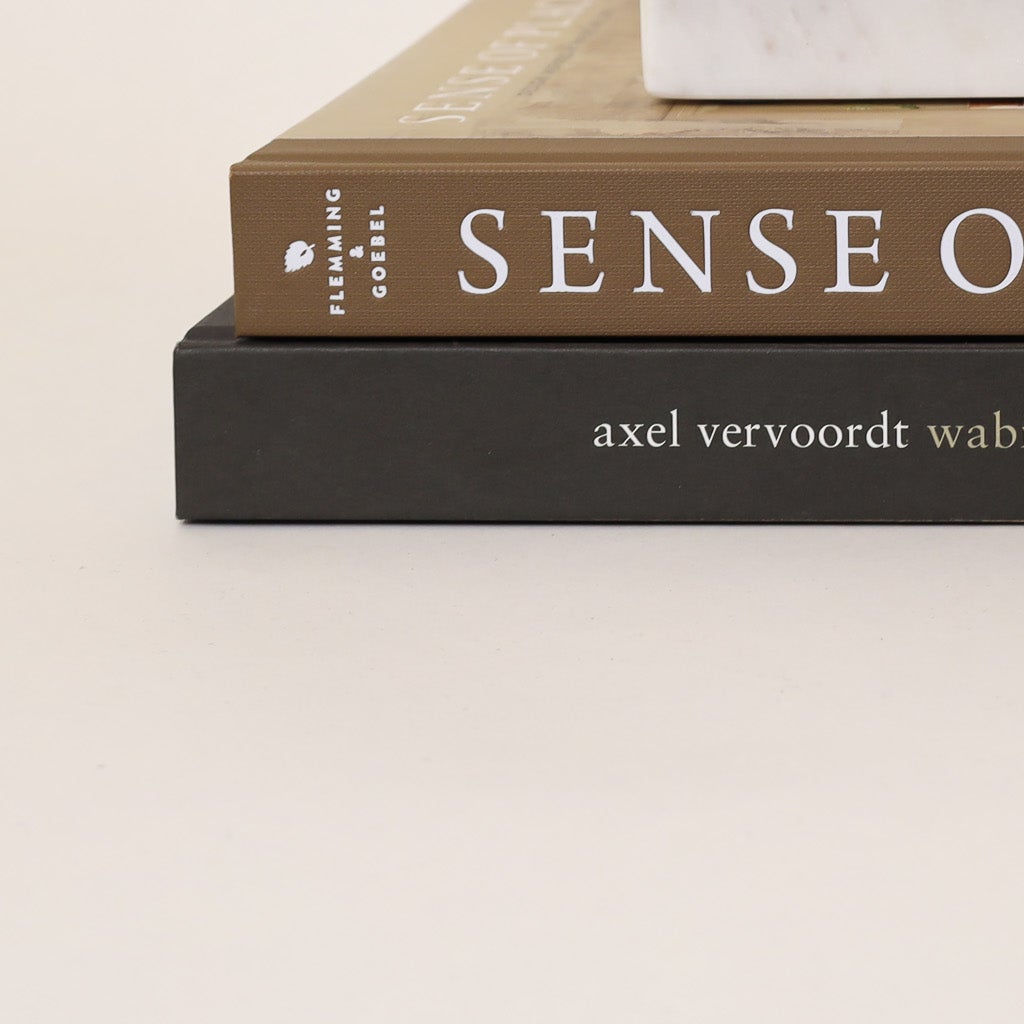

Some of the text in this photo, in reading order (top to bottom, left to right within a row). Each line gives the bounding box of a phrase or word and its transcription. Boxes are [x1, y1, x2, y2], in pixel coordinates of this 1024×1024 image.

[398, 65, 524, 124] SENSE
[325, 188, 346, 315] FLEMMING
[349, 245, 365, 259] &
[369, 205, 388, 299] GOEBEL
[457, 208, 890, 295] SENSE
[593, 408, 681, 448] axel
[697, 409, 910, 449] vervoordt
